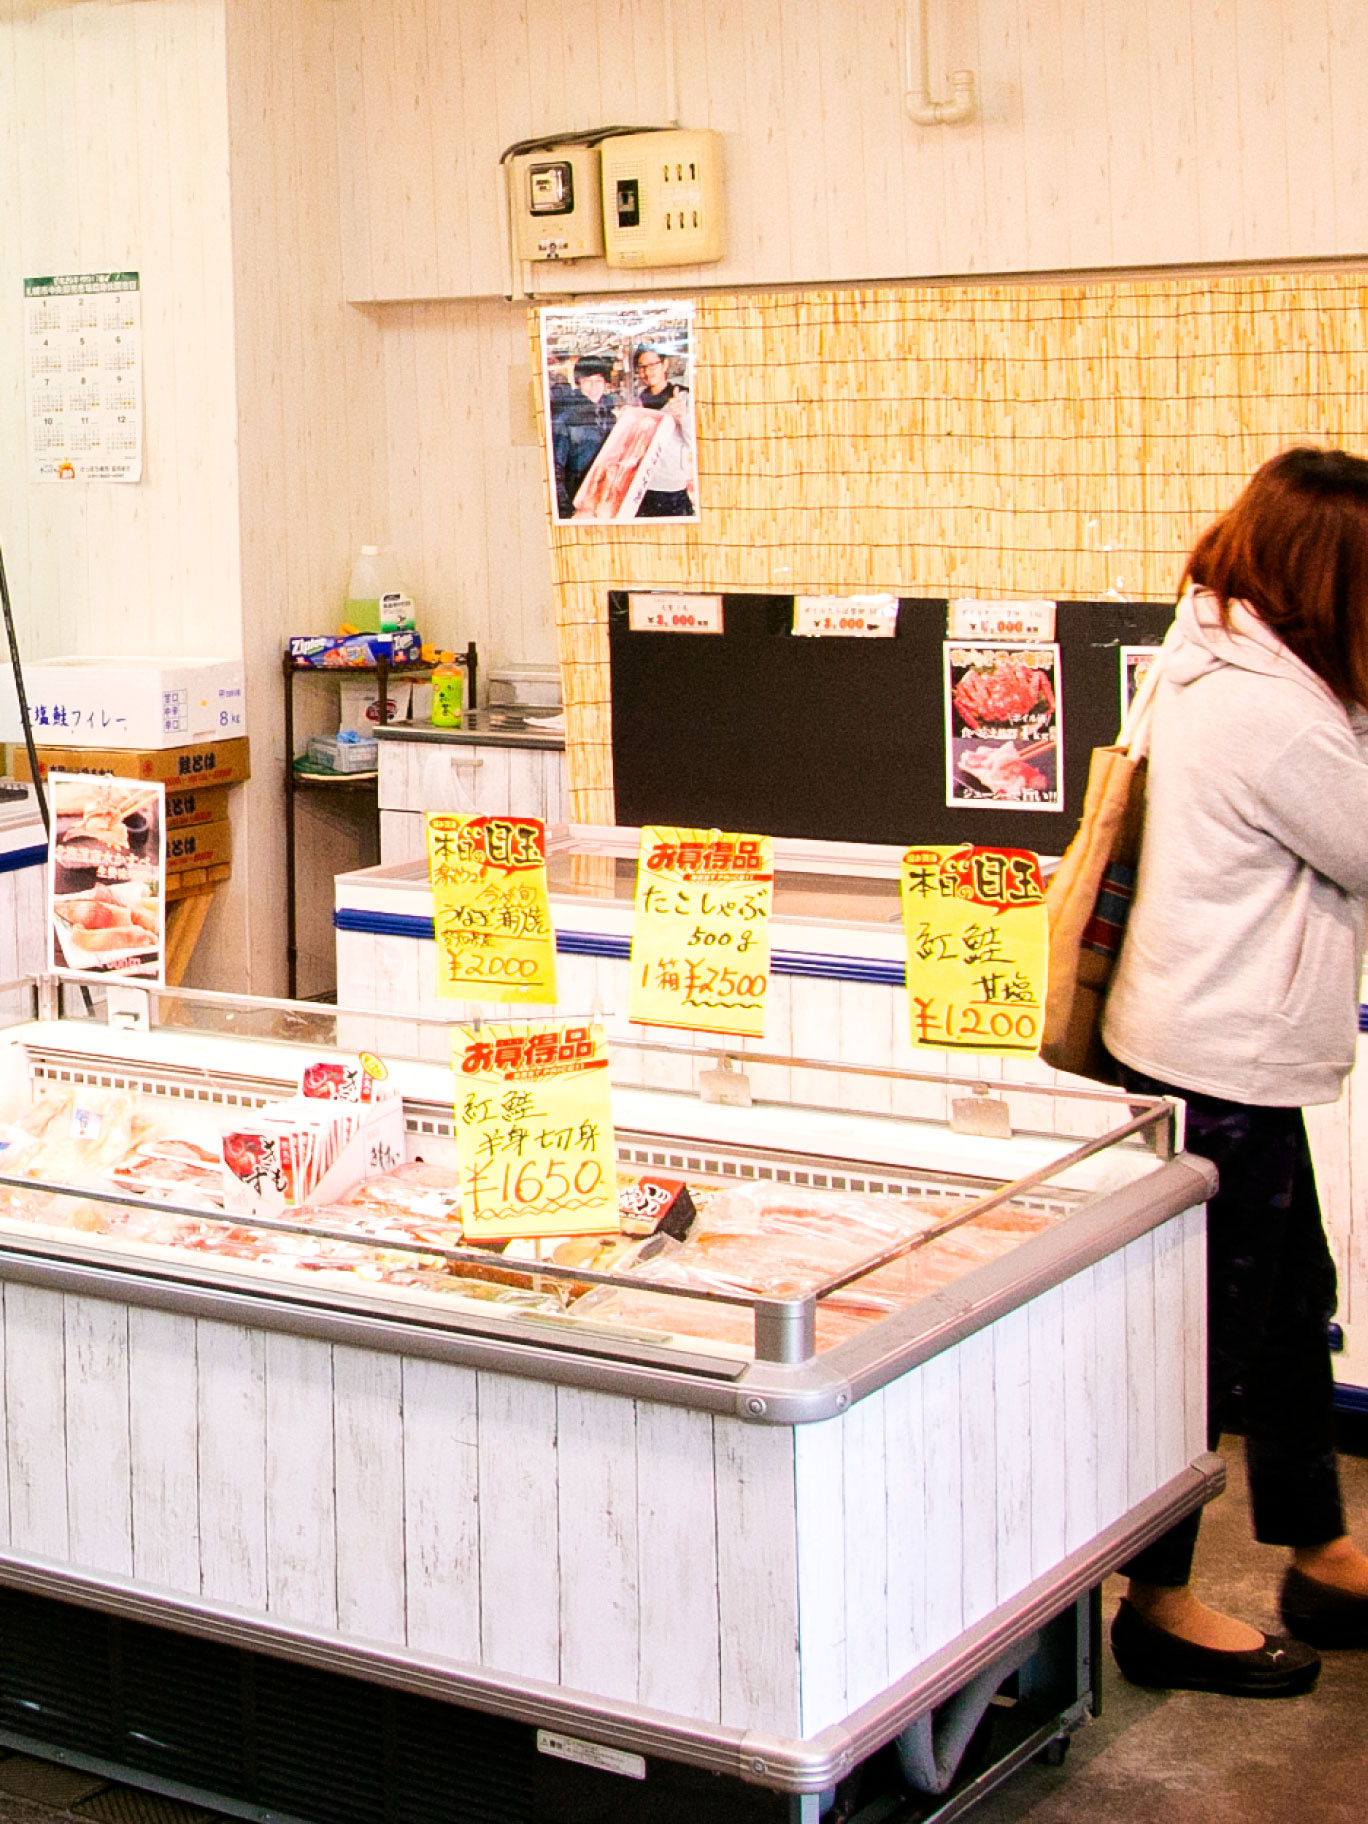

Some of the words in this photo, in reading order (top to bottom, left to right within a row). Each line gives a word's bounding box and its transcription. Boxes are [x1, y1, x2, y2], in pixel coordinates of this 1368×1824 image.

[20, 704, 127, 728] 塩鮭フィレー
[220, 711, 228, 726] 8
[434, 823, 544, 864] 本日の目玉
[647, 841, 763, 871] お買得品
[475, 882, 536, 908] 今が旬
[908, 855, 1044, 901] 本日の目玉
[643, 885, 768, 920] たこしゃぶ
[916, 922, 1016, 964] 紅鮭
[971, 972, 1036, 1003] 甘塩
[462, 1027, 595, 1072] お買得品
[462, 1091, 547, 1124] 紅鮭
[476, 1118, 600, 1156] 半身切身
